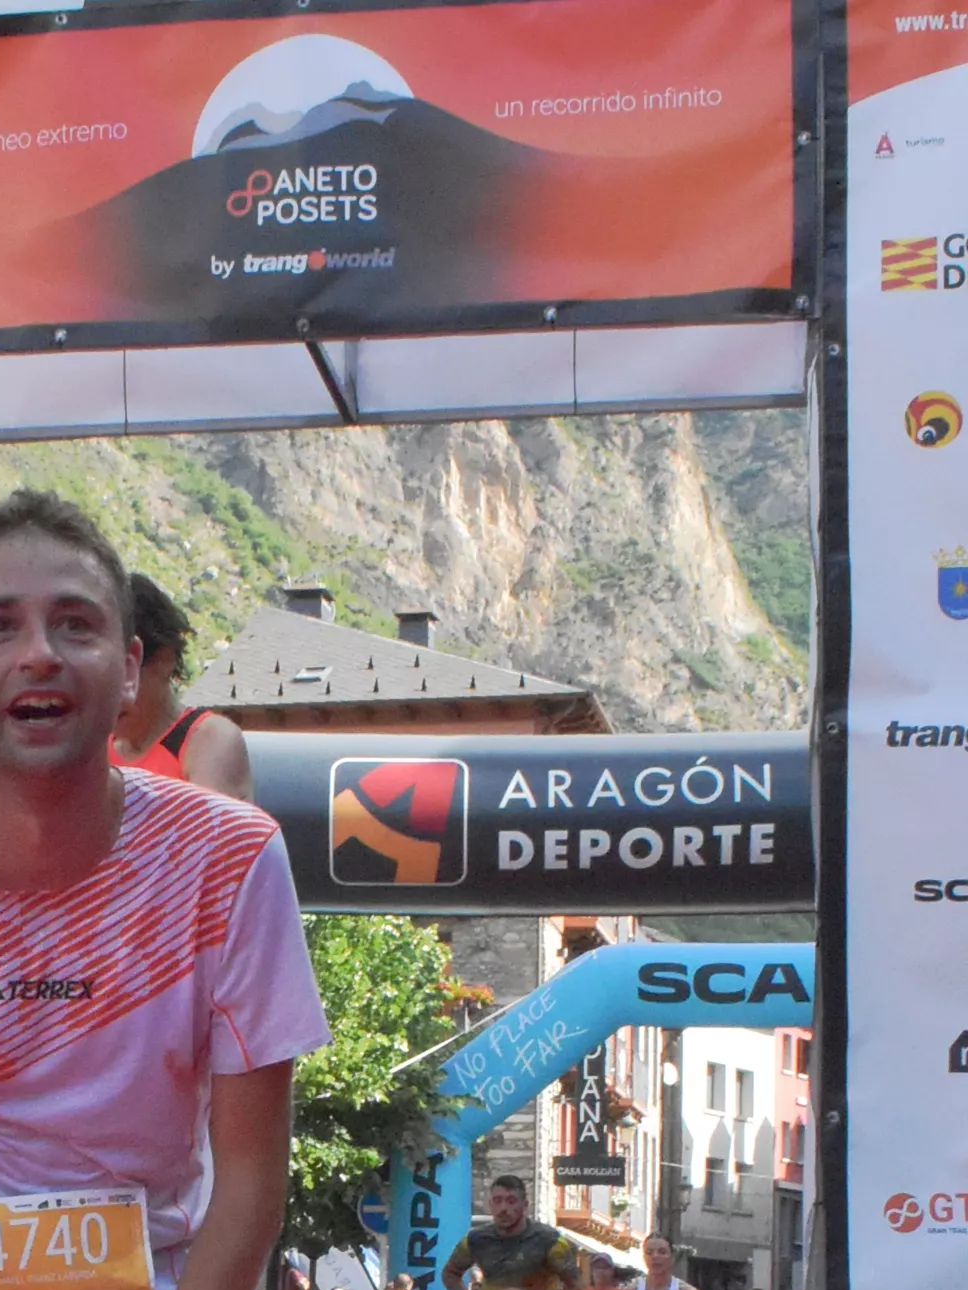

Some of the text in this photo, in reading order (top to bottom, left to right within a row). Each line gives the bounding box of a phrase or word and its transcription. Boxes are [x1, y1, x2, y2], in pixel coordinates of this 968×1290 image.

[495, 87, 722, 118] un recorrido infinito
[36, 121, 127, 148] extremo
[273, 164, 377, 195] ANETO
[257, 195, 377, 226] POSETS
[211, 247, 395, 279] by trangoworld
[886, 721, 968, 752] tran
[499, 755, 771, 809] ARAGÓN
[498, 823, 775, 871] DEPORTE
[7, 980, 95, 1000] TERREX
[637, 962, 811, 1004] SCA
[490, 987, 557, 1058] PLACE
[473, 1076, 515, 1115] TOO
[556, 1167, 581, 1176] CASA
